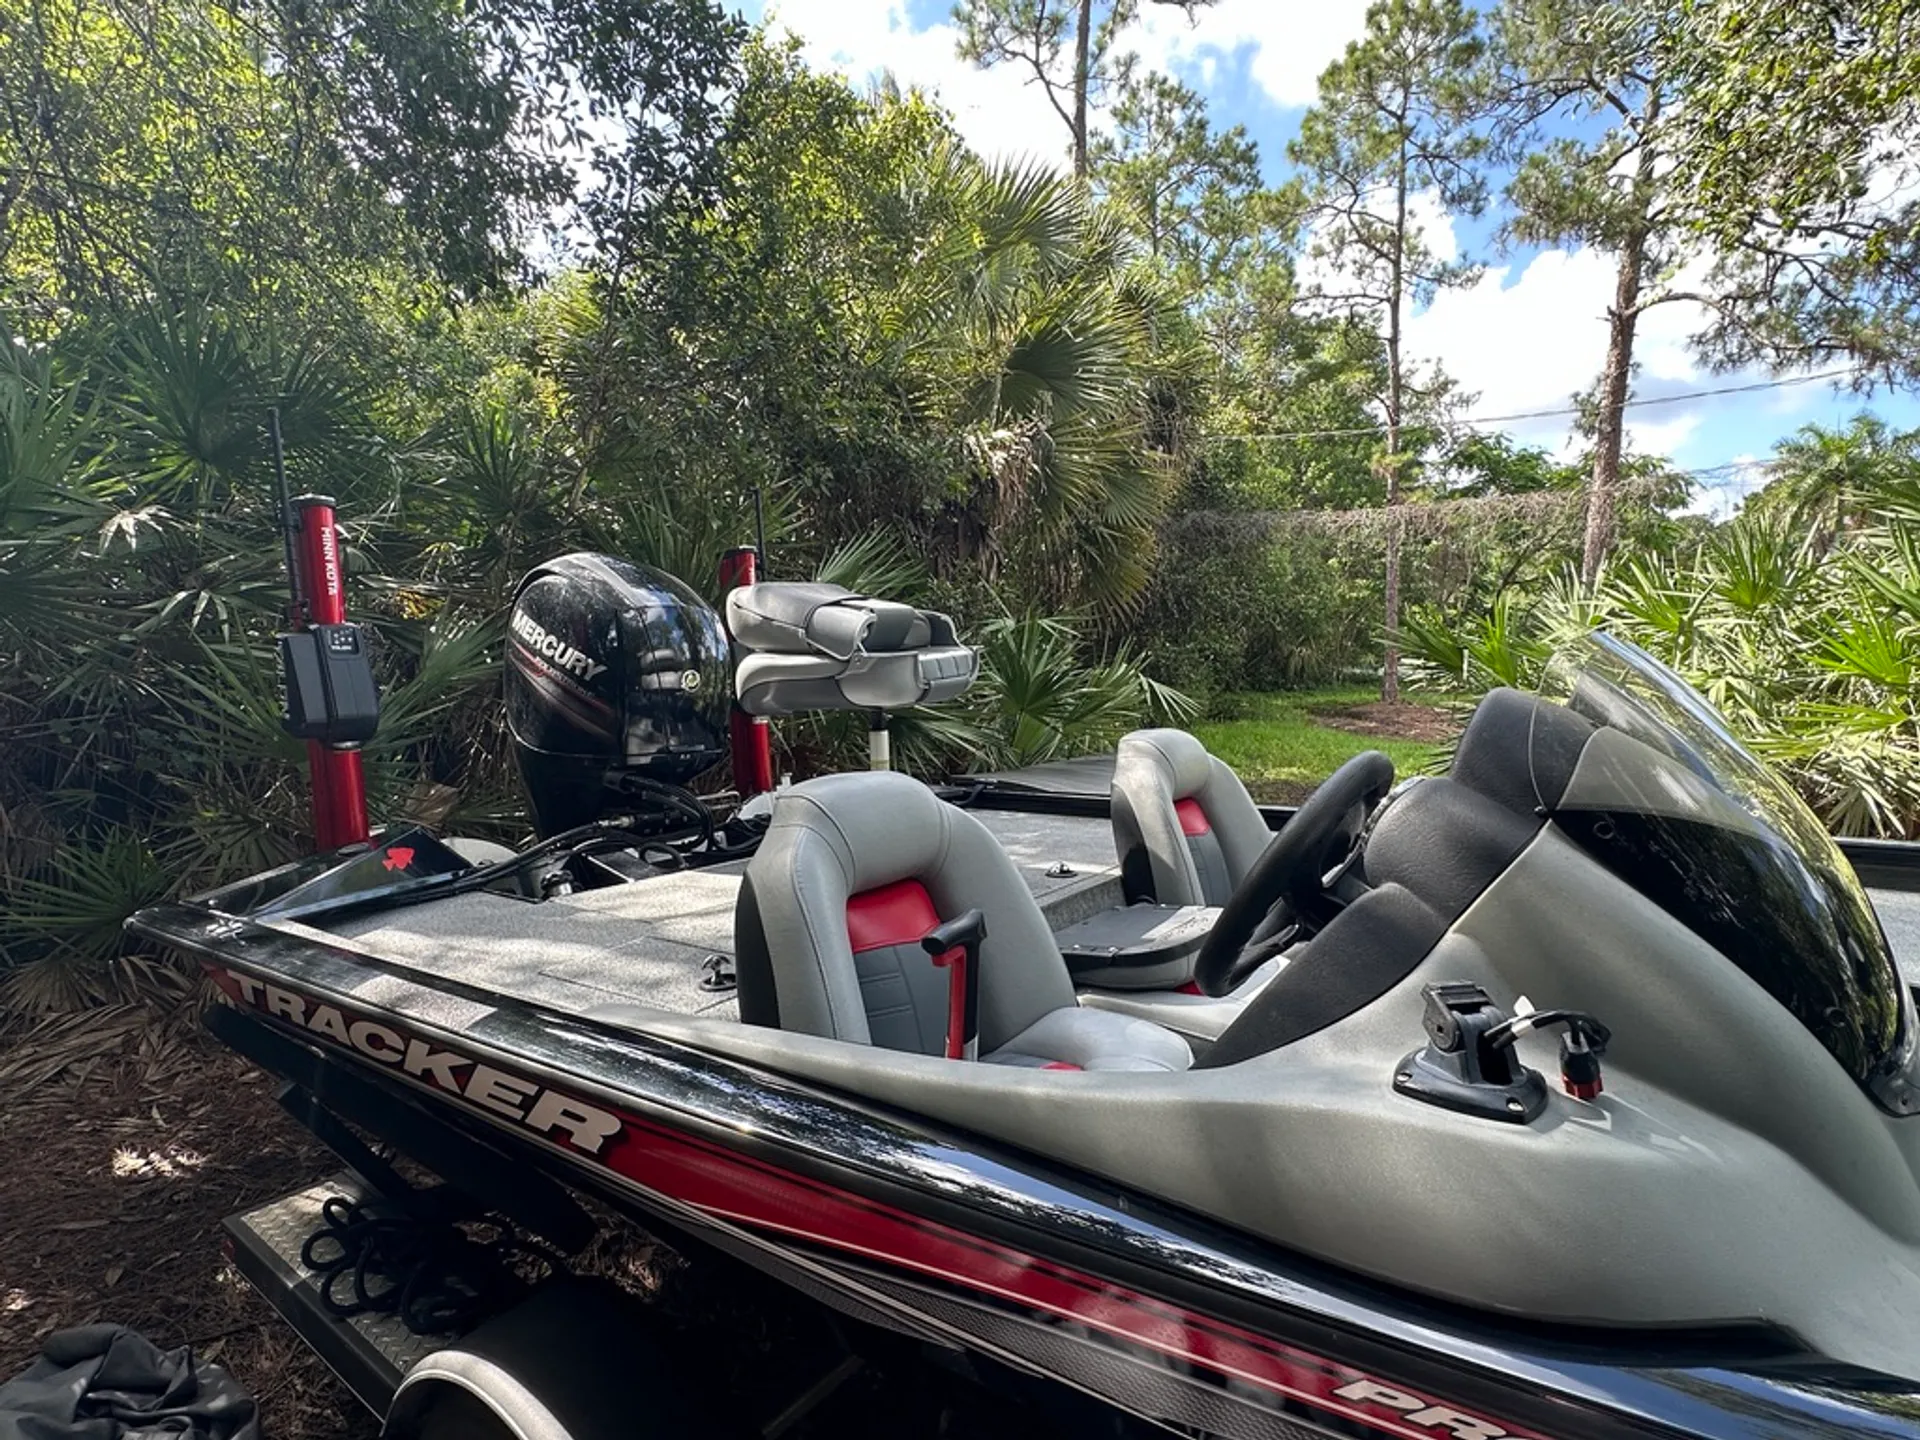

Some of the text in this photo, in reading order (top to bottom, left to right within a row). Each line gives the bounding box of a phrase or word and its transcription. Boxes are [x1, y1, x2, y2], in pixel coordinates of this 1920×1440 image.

[321, 526, 338, 595] MINN KOTA
[511, 609, 608, 681] MERCURY
[226, 969, 622, 1154] TRACKER
[1332, 1379, 1530, 1440] PR
